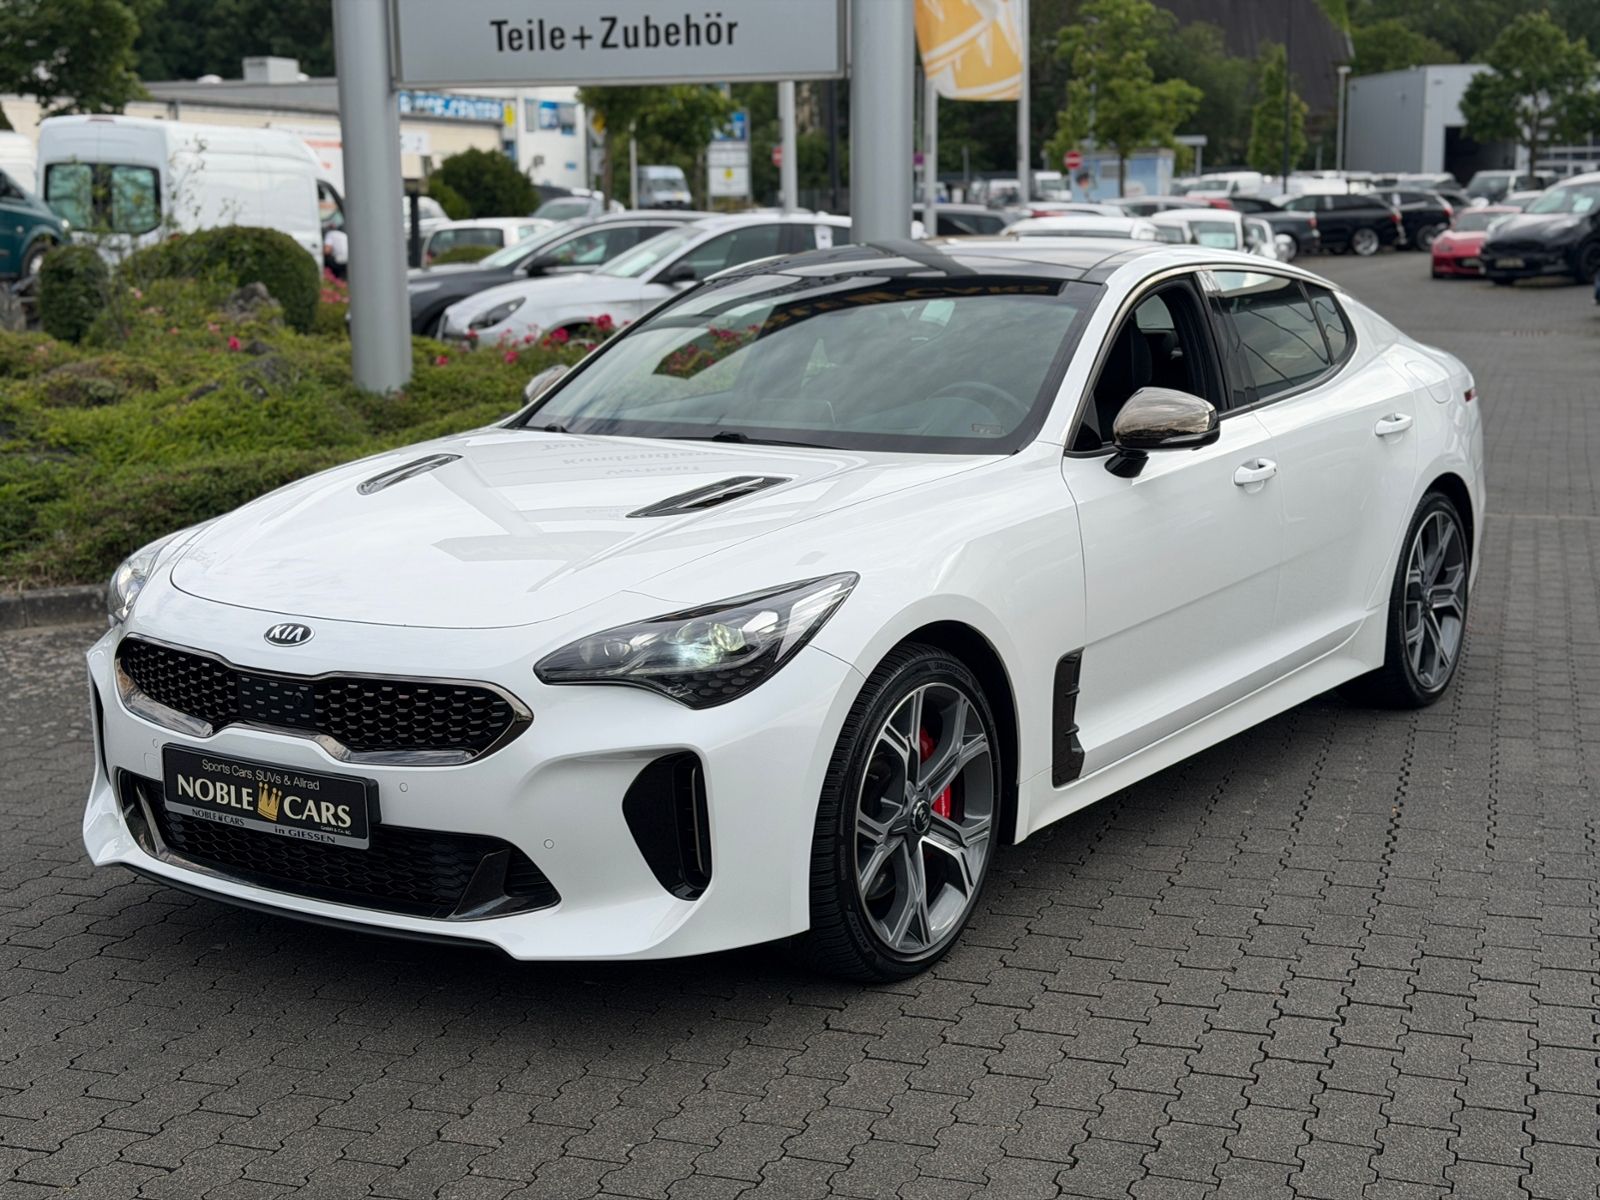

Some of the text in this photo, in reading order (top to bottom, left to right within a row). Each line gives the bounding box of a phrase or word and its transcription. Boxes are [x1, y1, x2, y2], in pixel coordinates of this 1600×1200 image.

[268, 625, 305, 642] KIA
[202, 759, 320, 791] Sports Cars, SUVs & Allrad
[177, 773, 352, 828] NOBLE CARS
[191, 808, 245, 827] NOBLE CARS
[274, 825, 336, 844] in GIESSEN
